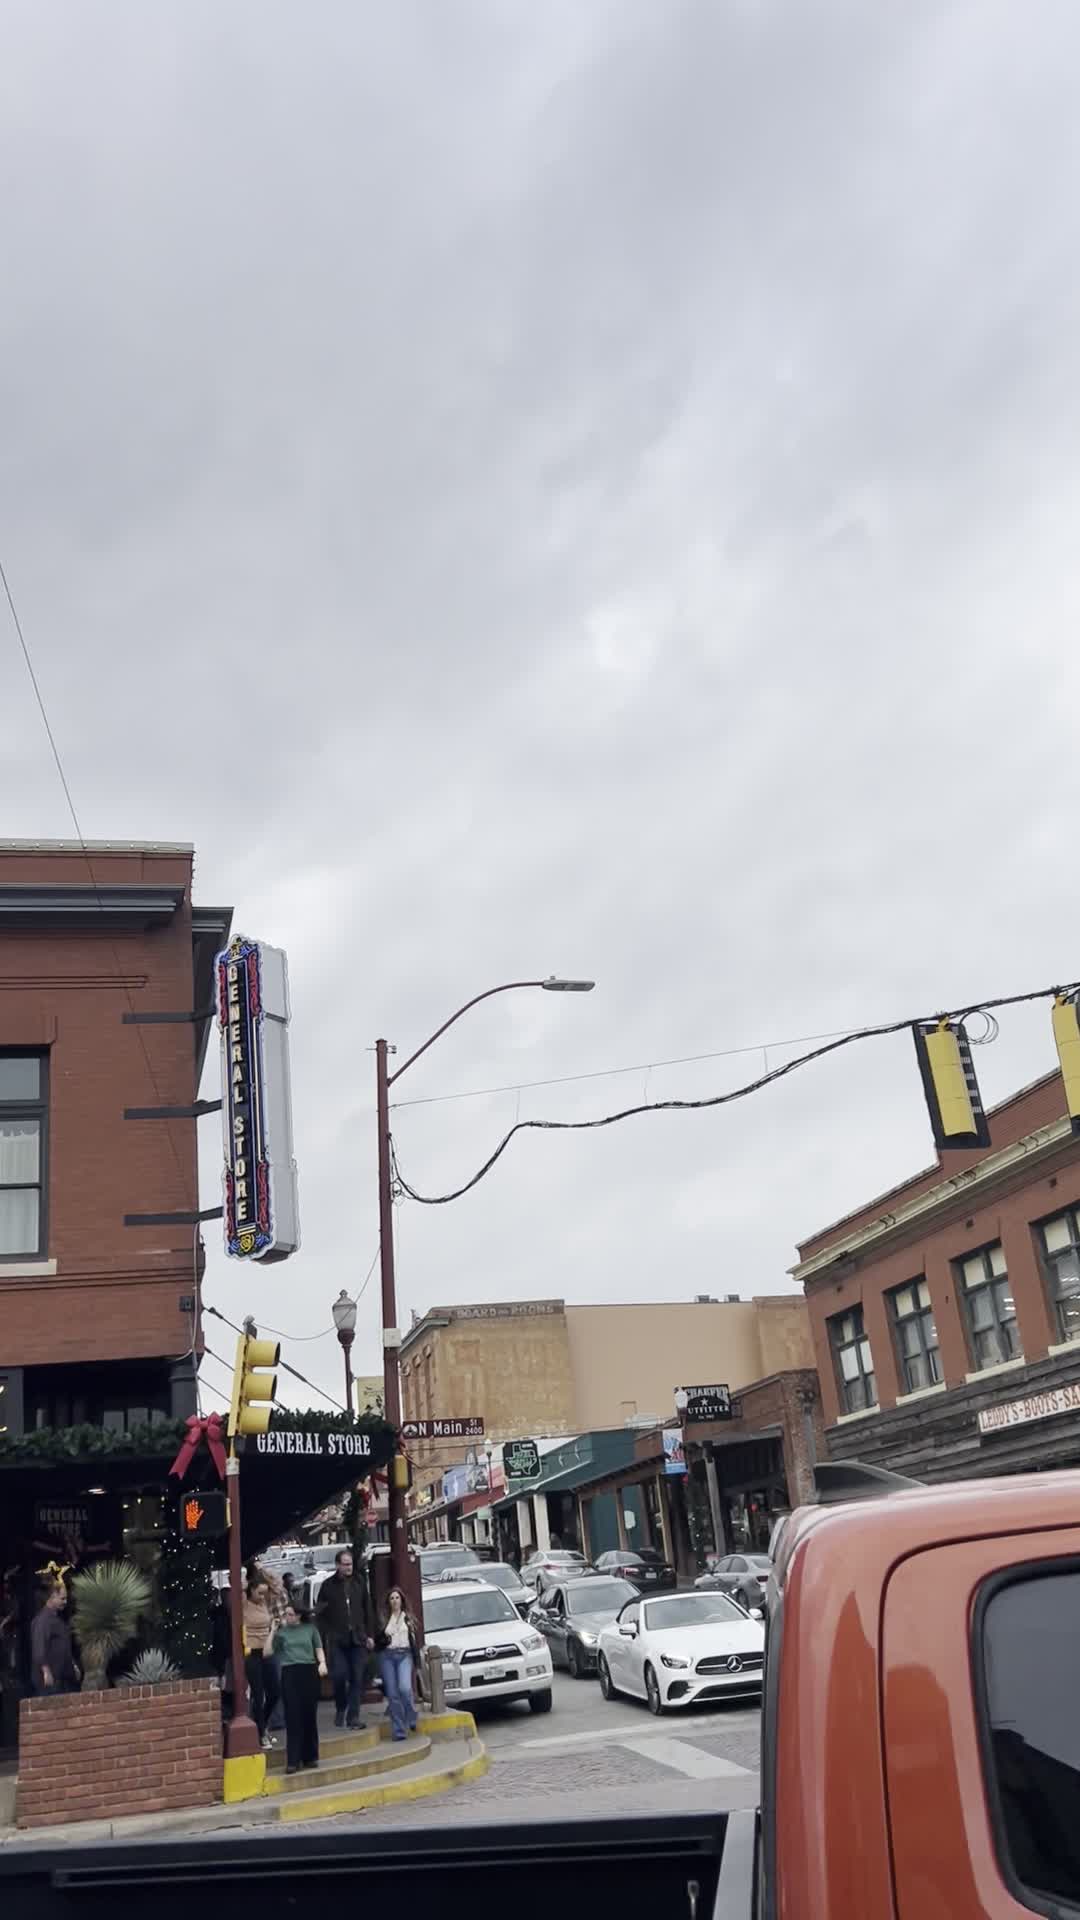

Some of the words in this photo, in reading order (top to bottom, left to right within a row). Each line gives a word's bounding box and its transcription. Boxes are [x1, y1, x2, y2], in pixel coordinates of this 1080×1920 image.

[227, 964, 244, 1104] GENERAL
[233, 1115, 248, 1222] STORE
[418, 1422, 427, 1436] N
[433, 1420, 462, 1435] Main
[465, 1426, 483, 1435] 2400
[256, 1431, 323, 1454] GENERAL
[327, 1433, 371, 1456] STORE
